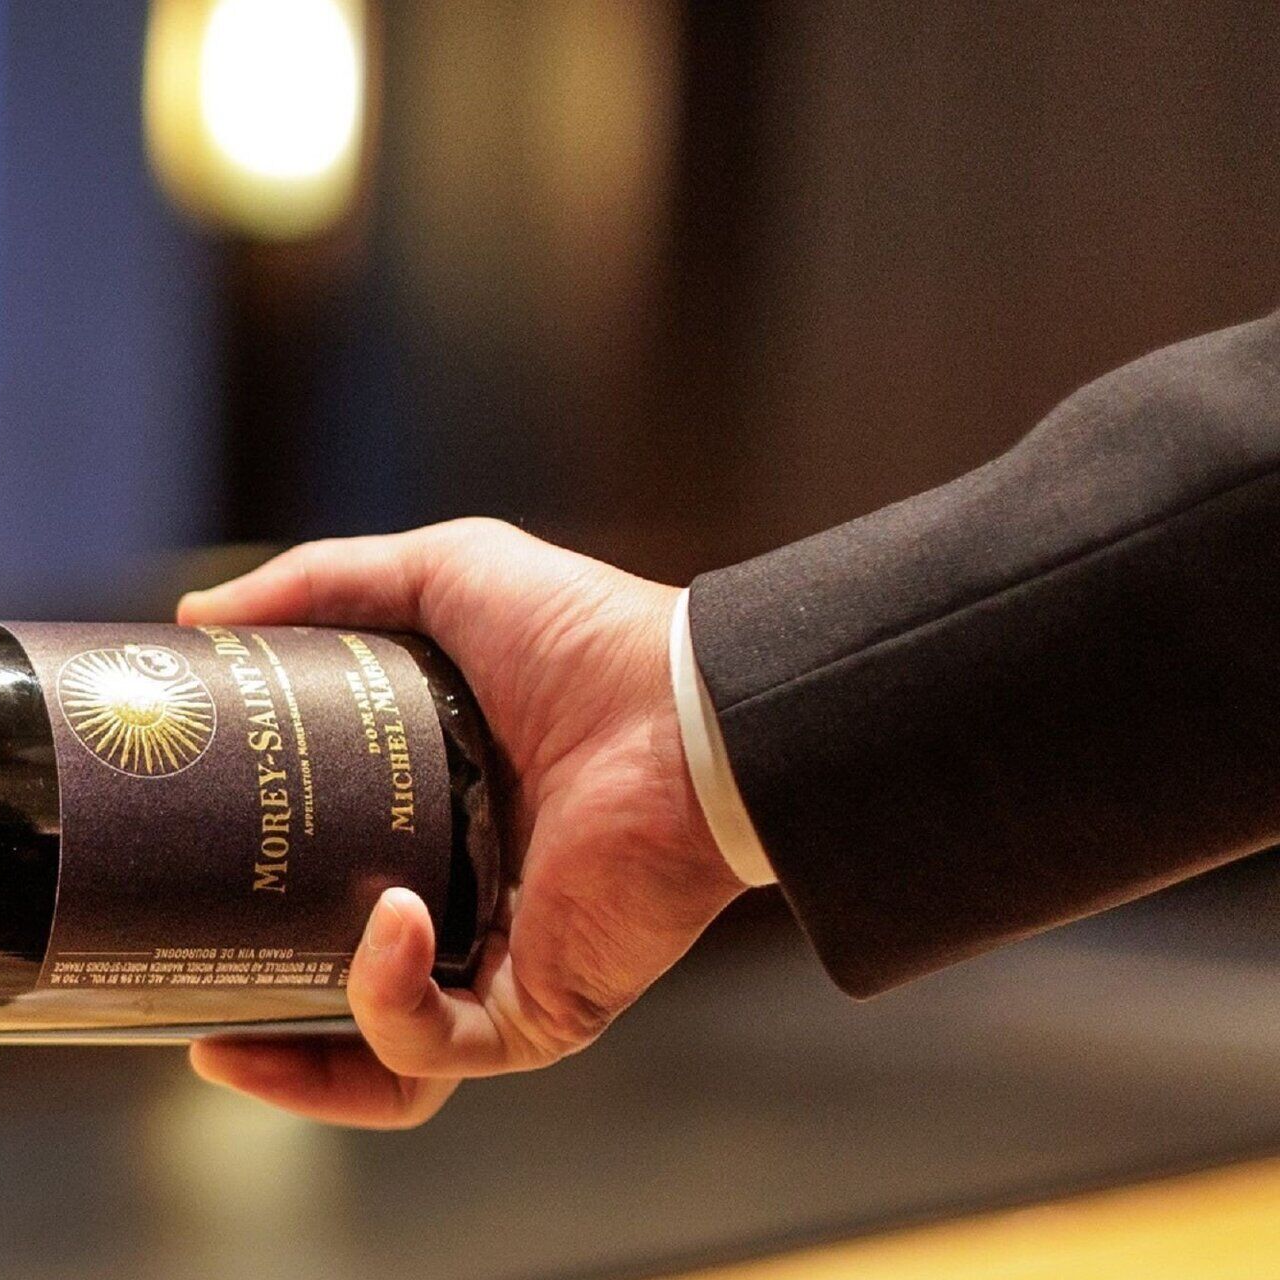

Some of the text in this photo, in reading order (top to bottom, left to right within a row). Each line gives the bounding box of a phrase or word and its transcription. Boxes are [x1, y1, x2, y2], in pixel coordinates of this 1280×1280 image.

[346, 671, 381, 755] DOMAINE
[384, 720, 415, 834] MICHEL
[302, 759, 315, 836] APPELLATION
[153, 947, 294, 959] GRAND VIN DE BOURGOGNE
[53, 961, 85, 972] FRANCE
[170, 973, 202, 984] FRANCE
[201, 973, 214, 984] OF
[213, 973, 250, 984] PRODUCT
